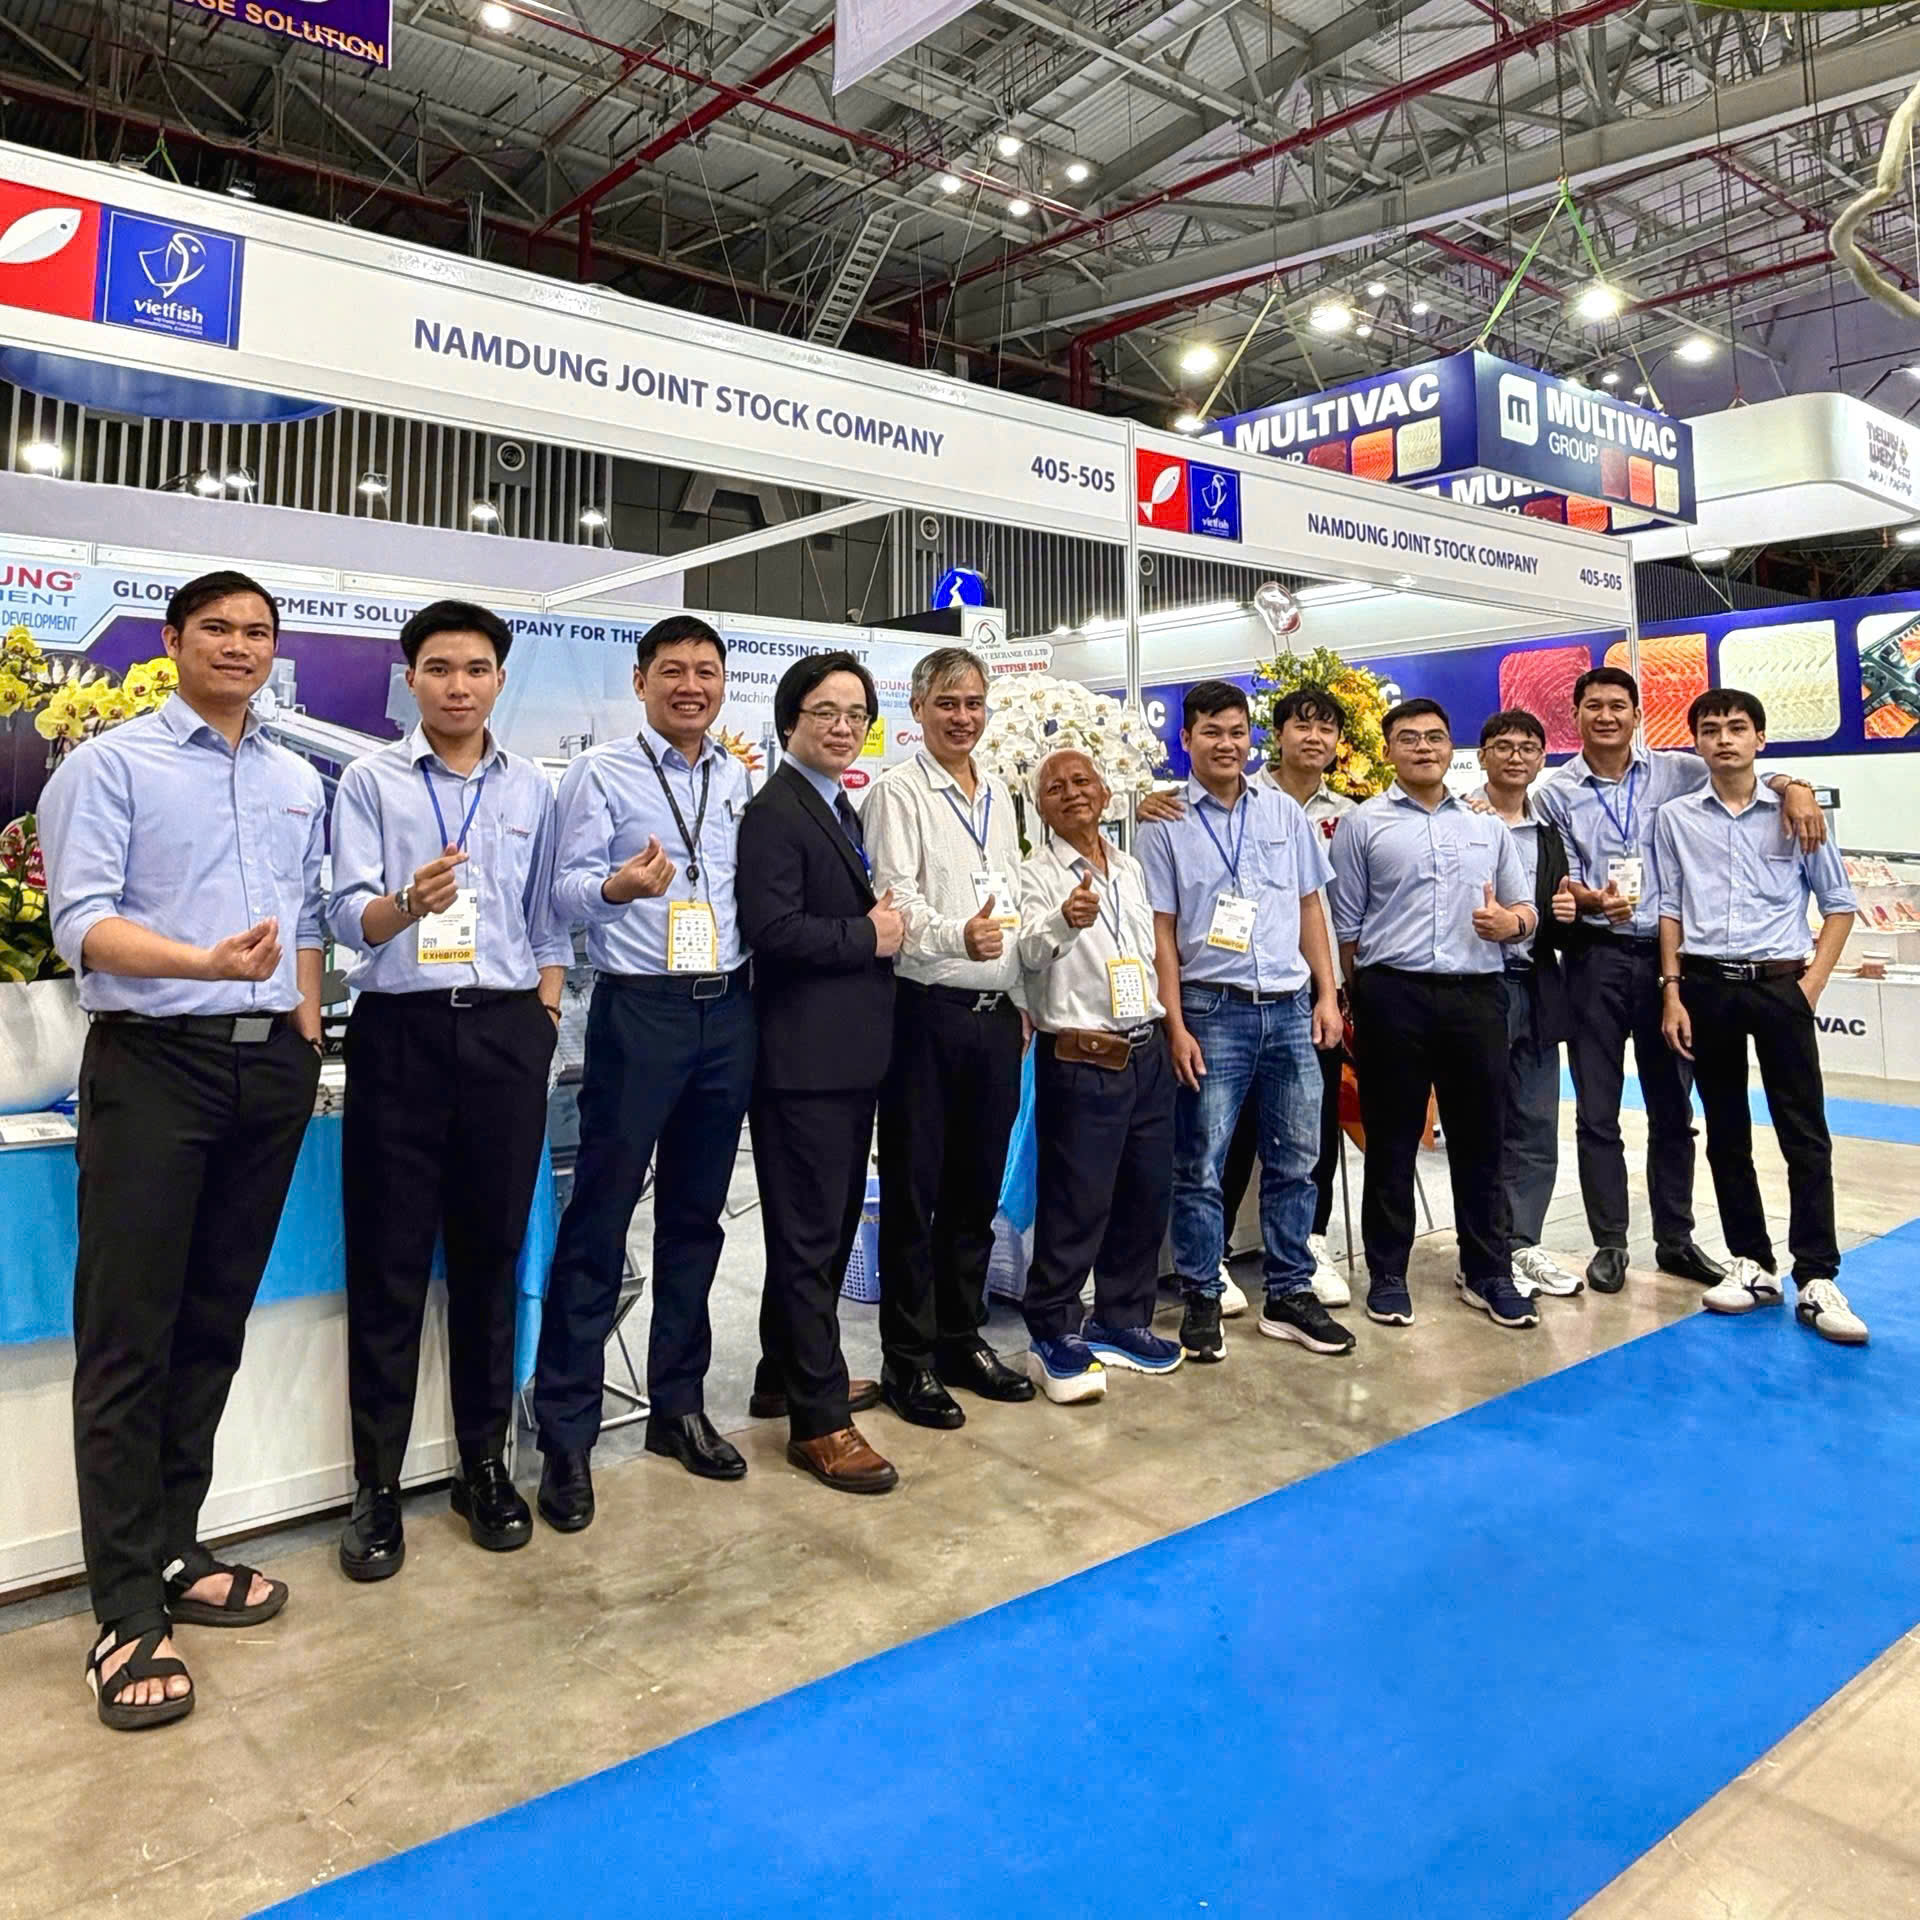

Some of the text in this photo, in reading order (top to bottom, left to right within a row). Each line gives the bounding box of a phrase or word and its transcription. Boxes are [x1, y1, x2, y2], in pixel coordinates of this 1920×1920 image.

[245, 3, 384, 64] SOLUTION
[134, 299, 203, 324] vietfish
[414, 318, 944, 457] NAMDUNG JOINT STOCK COMPANY
[1236, 373, 1441, 453] MULTIVAC
[1546, 387, 1678, 460] MULTIVAC
[1548, 431, 1599, 464] GROUP
[1031, 455, 1116, 493] 405-505
[1308, 513, 1539, 575] NAMDUNG JOINT STOCK COMPANY
[1579, 567, 1623, 591] 405-505
[2, 610, 78, 632] DEVELOPMENT
[113, 580, 178, 601] GLOB
[275, 596, 348, 618] PMENT
[354, 604, 420, 624] SOLUT
[570, 624, 606, 642] FOR
[610, 627, 643, 645] THE
[727, 639, 819, 658] PROCESSING
[723, 670, 778, 685] EMPURA
[991, 663, 1027, 674] VIETFISH
[1452, 761, 1473, 770] VAC
[423, 951, 471, 960] EXHIBITOR
[1815, 1016, 1867, 1036] VAC
